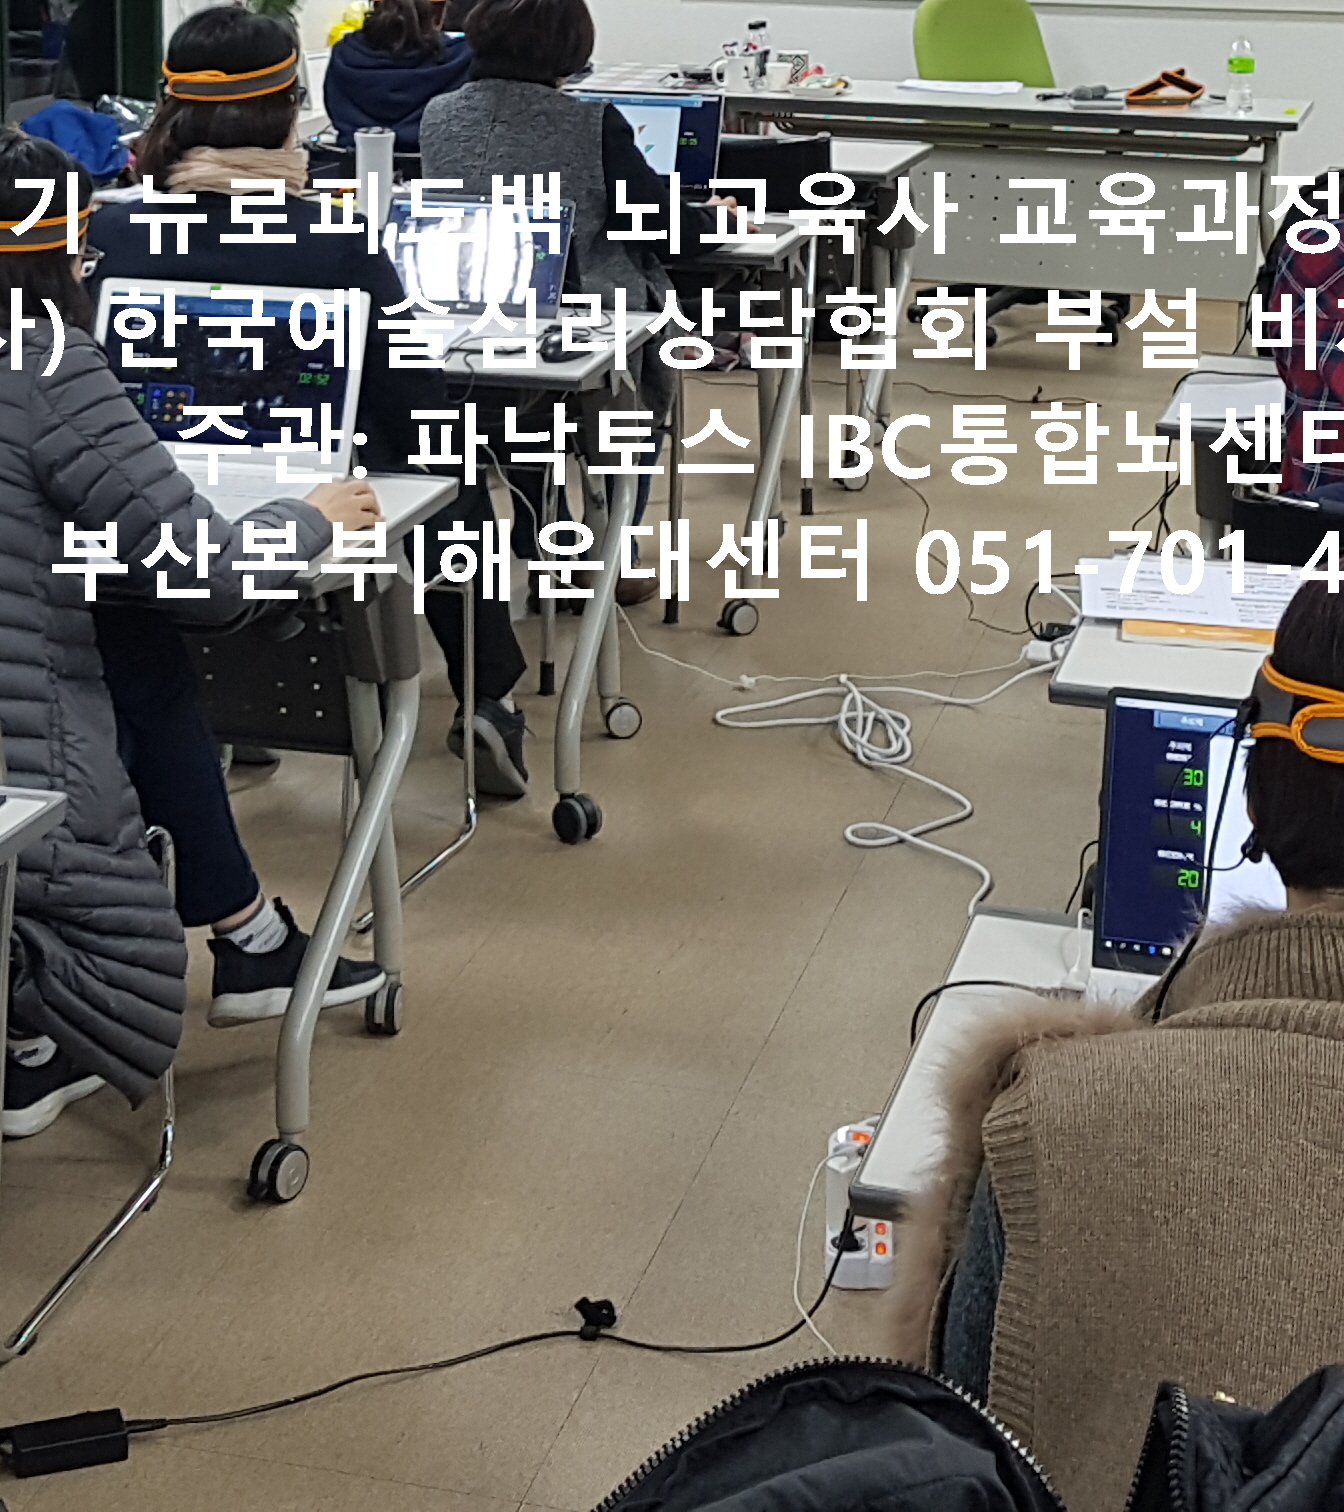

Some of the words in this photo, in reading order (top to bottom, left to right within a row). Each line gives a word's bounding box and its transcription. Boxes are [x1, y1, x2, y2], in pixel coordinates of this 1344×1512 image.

[1183, 767, 1205, 787] 30
[1189, 819, 1202, 836] 4
[1176, 868, 1200, 888] 20
